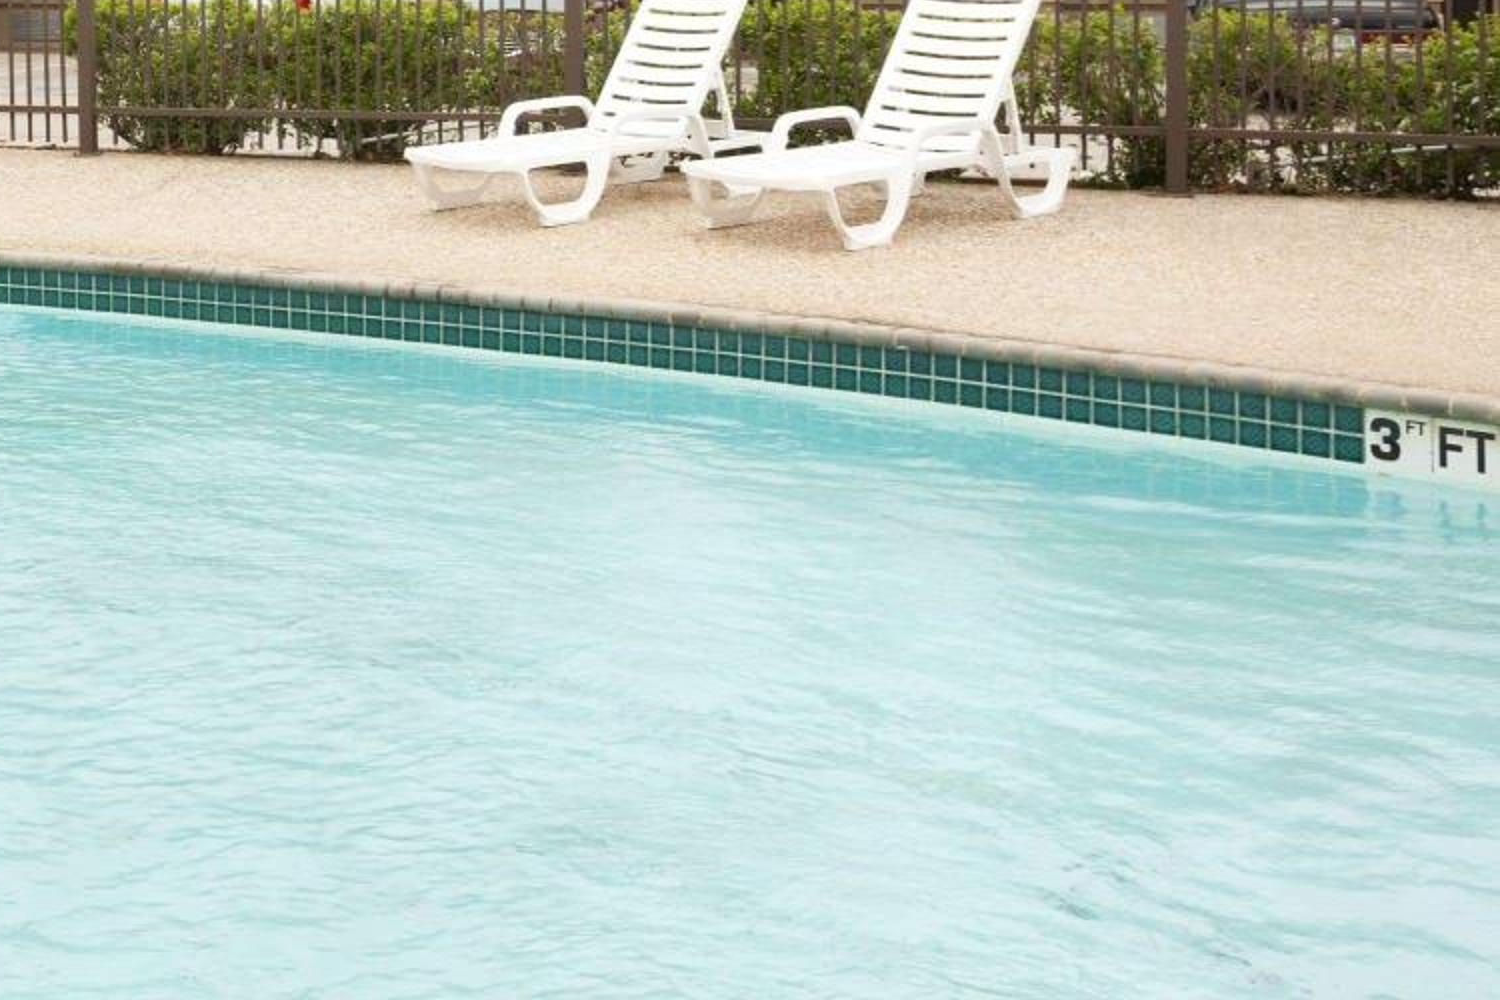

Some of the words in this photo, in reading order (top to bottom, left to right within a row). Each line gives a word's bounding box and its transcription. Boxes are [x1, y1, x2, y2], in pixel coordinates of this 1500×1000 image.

[1370, 417, 1401, 461] 3
[1405, 420, 1426, 436] FT
[1439, 426, 1495, 474] FT
